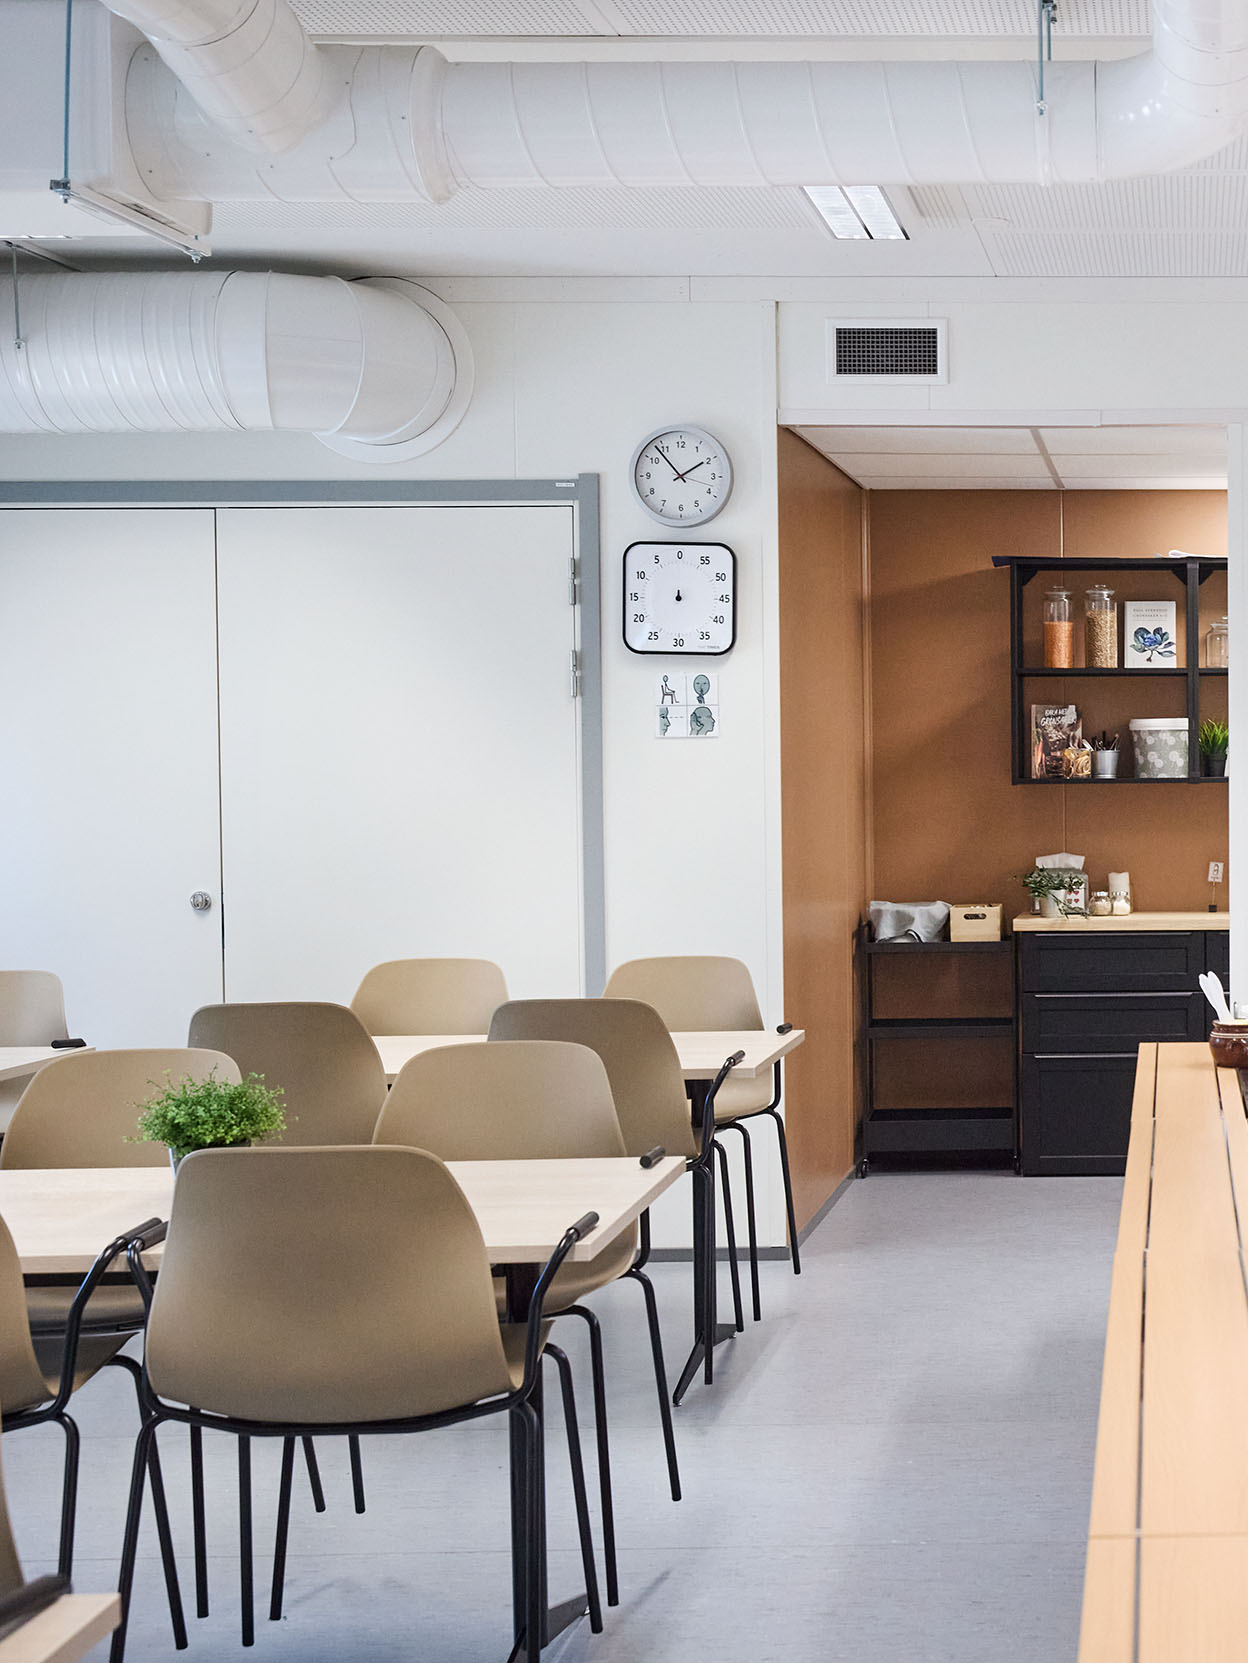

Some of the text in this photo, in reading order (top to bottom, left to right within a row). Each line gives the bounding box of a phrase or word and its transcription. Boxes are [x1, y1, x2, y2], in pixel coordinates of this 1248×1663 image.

[706, 457, 712, 465] 2
[645, 472, 651, 480] 9
[649, 487, 655, 495] 8
[661, 499, 667, 507] 7
[678, 504, 684, 512] 6
[654, 555, 660, 564] 5
[677, 550, 683, 560] 0
[700, 556, 710, 565] 55
[636, 570, 646, 580] 10
[715, 572, 727, 582] 50
[629, 592, 639, 602] 15
[719, 594, 730, 603] 45
[633, 613, 645, 623] 20
[712, 615, 725, 624] 40
[647, 631, 659, 640] 25
[699, 631, 711, 640] 35
[673, 638, 685, 647] 30
